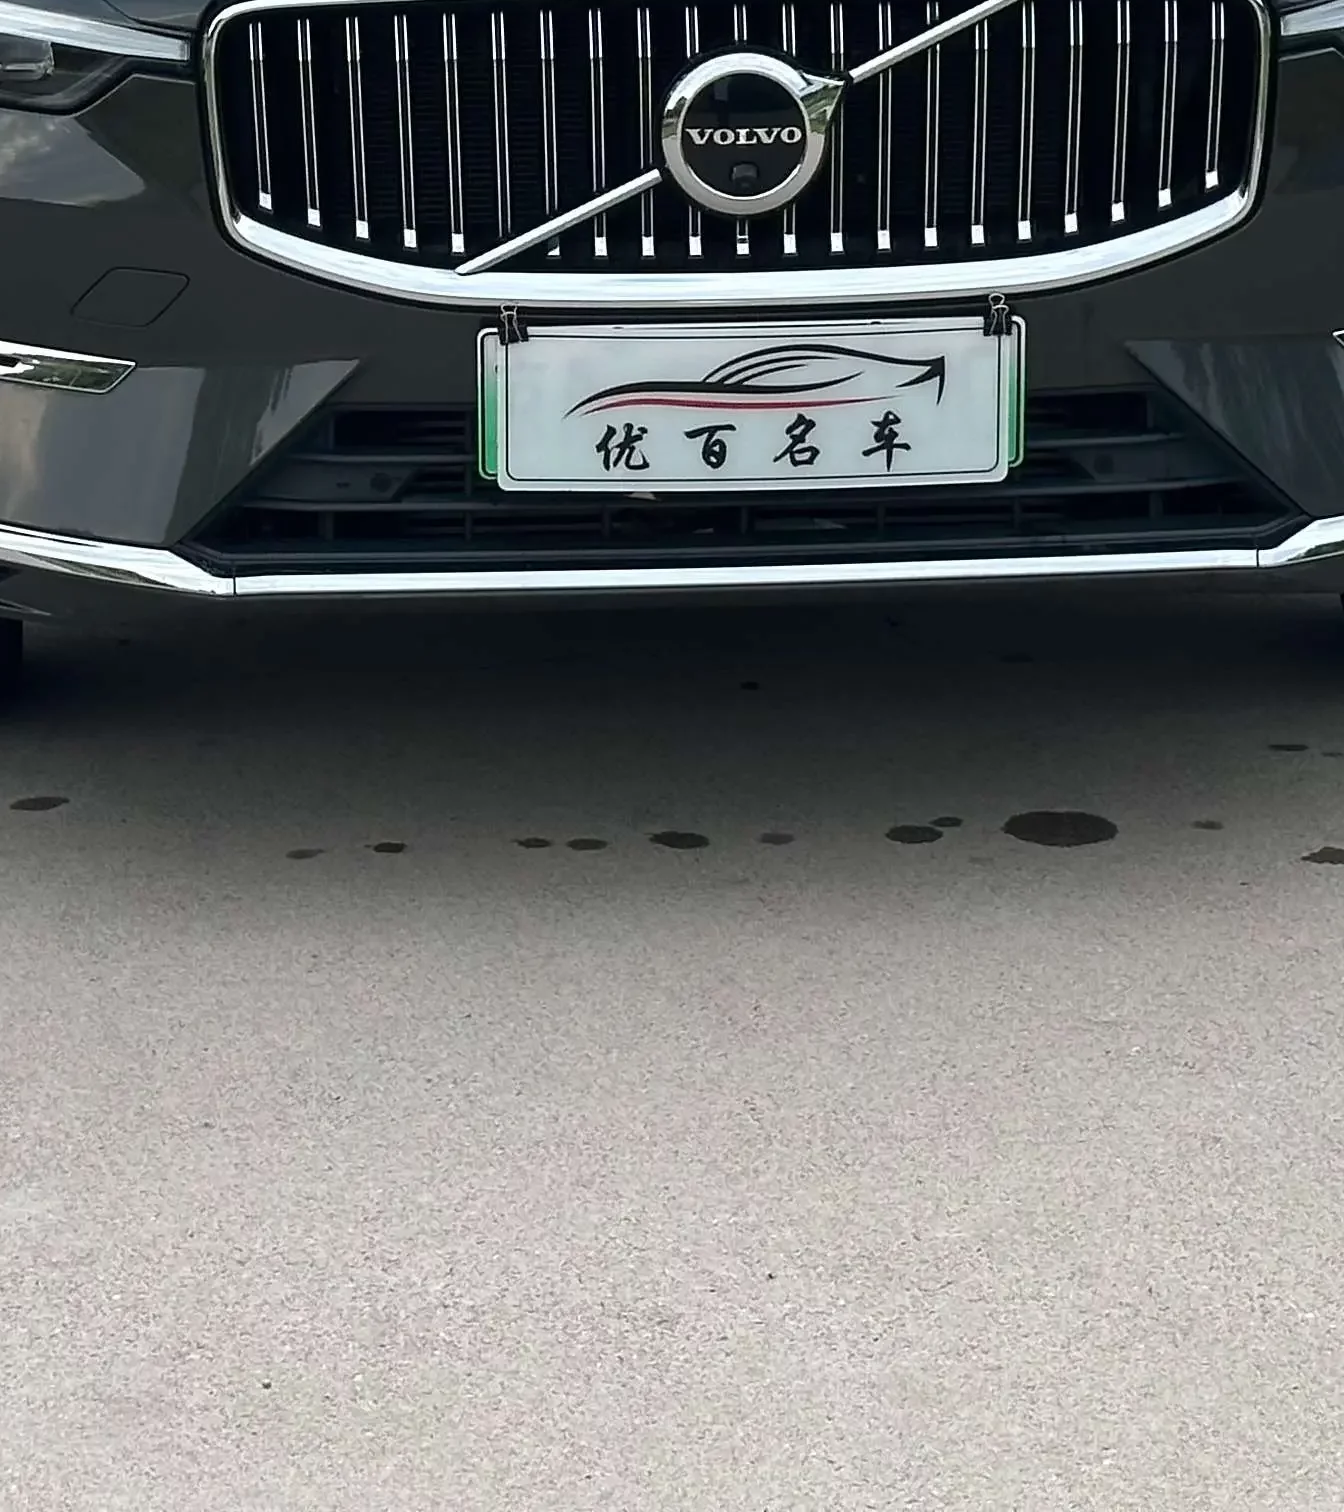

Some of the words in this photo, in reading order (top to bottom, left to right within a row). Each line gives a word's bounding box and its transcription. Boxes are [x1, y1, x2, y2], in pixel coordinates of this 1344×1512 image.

[683, 125, 803, 146] VOLVO
[595, 410, 912, 473] 优百名车
